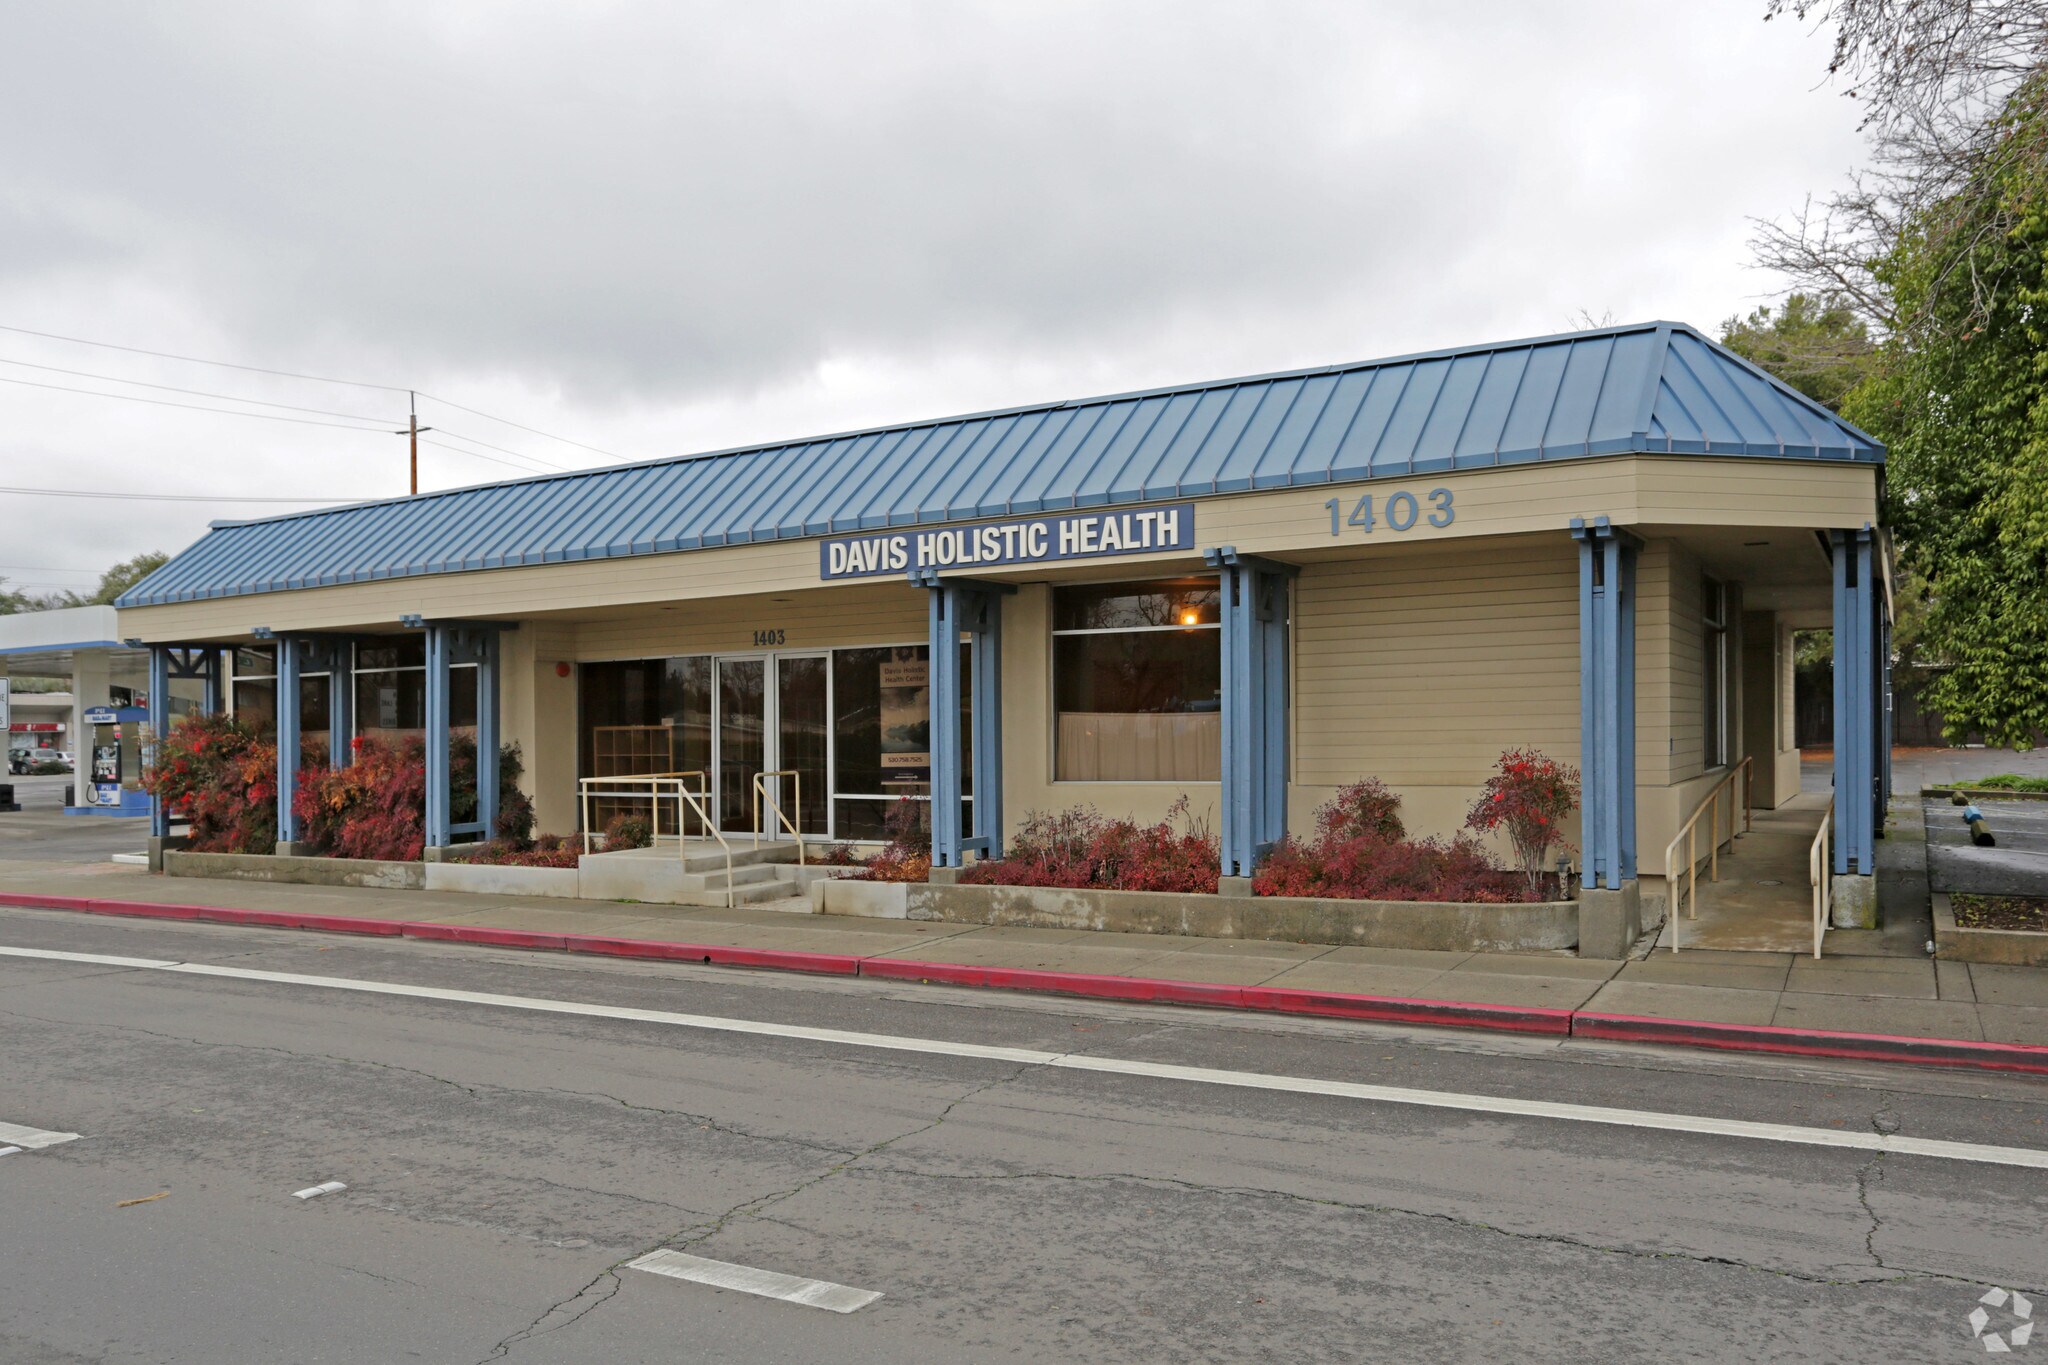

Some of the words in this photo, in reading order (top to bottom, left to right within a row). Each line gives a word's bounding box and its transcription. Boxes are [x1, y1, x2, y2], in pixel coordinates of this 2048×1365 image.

[1325, 488, 1455, 536] 1403
[829, 536, 908, 574] DAVIS
[917, 522, 1048, 567] HOLISTIC
[1059, 509, 1179, 555] HEALTH
[753, 629, 786, 646] 1403
[903, 666, 926, 674] Holistic
